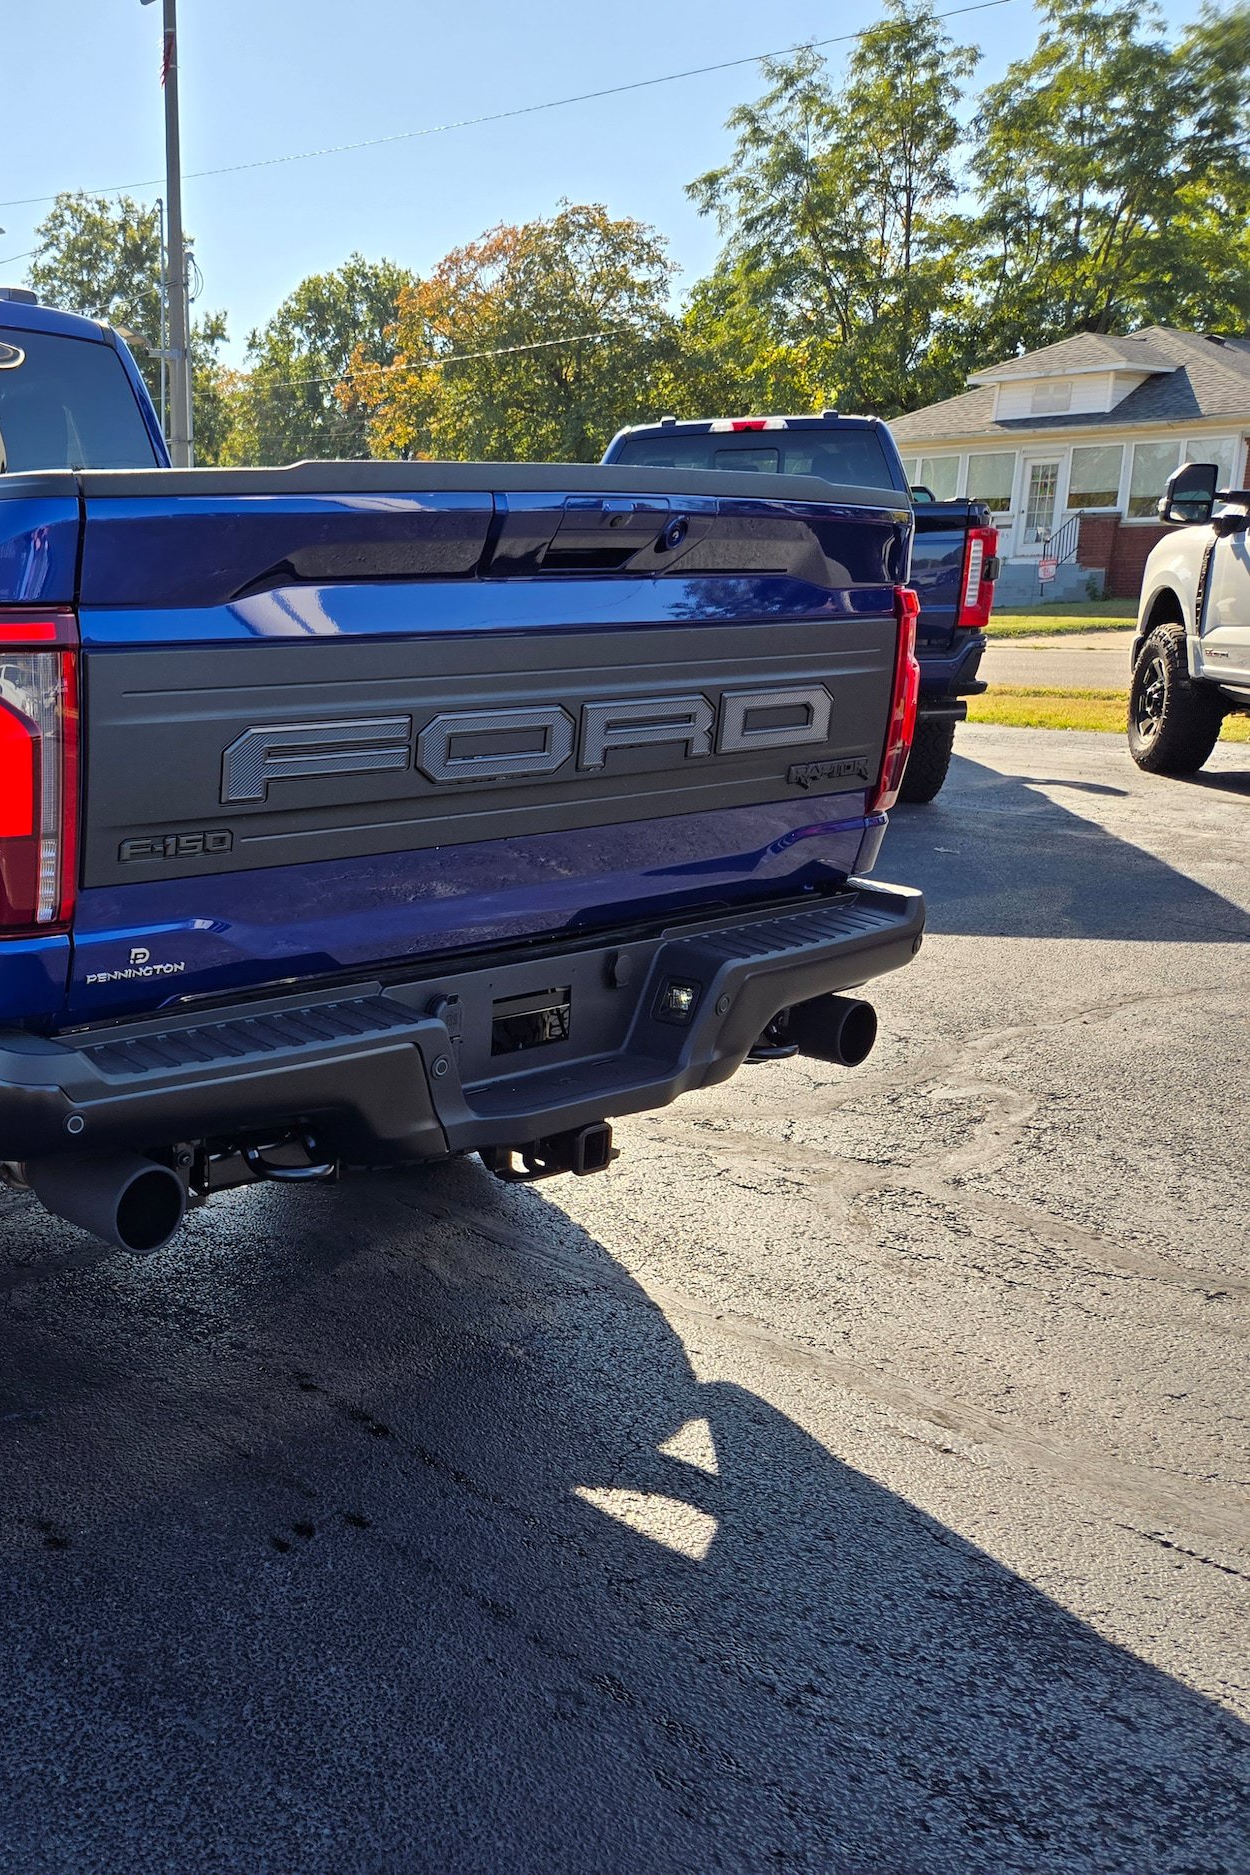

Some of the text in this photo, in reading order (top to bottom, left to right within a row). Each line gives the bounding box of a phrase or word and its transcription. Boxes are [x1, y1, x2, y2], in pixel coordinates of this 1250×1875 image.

[220, 682, 834, 803] FORD
[787, 755, 869, 790] RAPTOR
[118, 829, 233, 863] F-150
[86, 962, 185, 984] PENNINGTON
